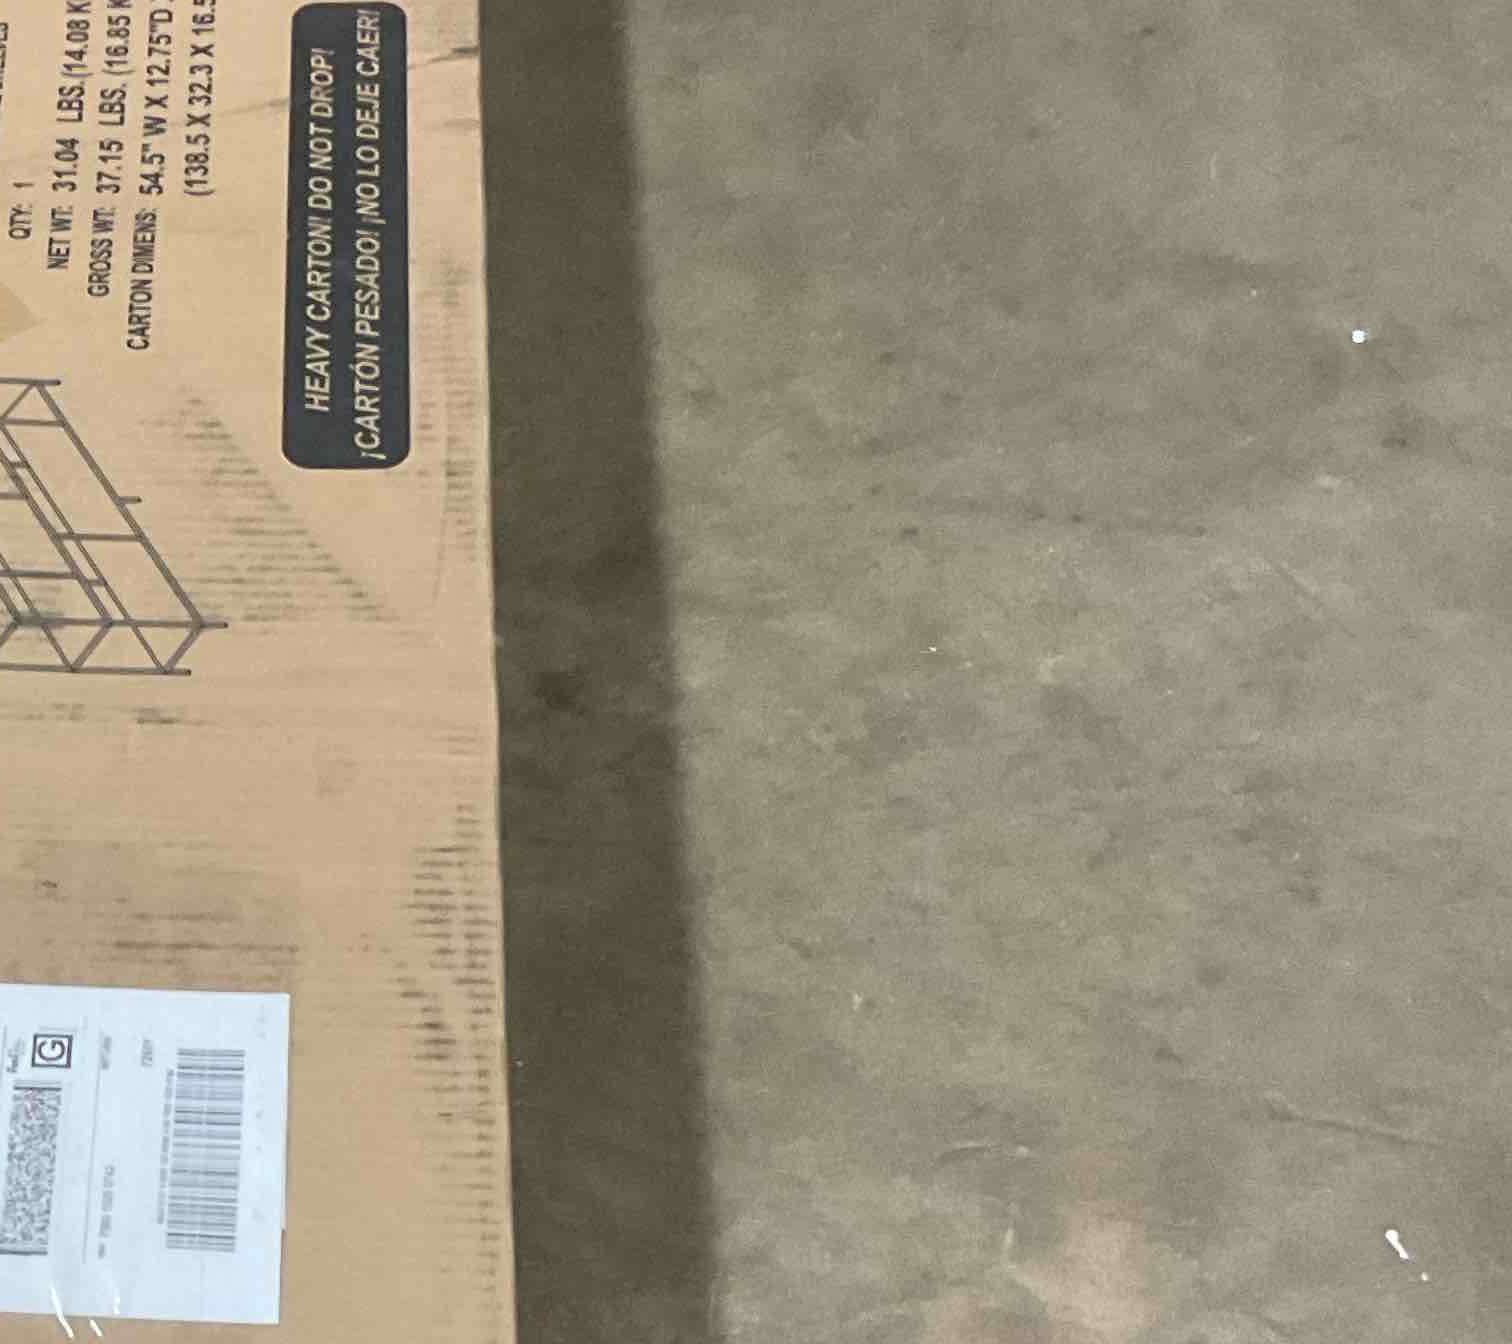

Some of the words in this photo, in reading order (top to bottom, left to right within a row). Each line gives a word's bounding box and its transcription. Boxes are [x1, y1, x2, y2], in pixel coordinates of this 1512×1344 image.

[101, 15, 136, 75] (16.85
[145, 9, 174, 88] 12.75"D
[190, 43, 214, 58] X
[356, 8, 382, 76] CAER!
[98, 83, 128, 127] LBS.
[145, 95, 169, 109] X
[188, 64, 213, 107] 32.3
[309, 47, 336, 117] DROP!
[143, 116, 167, 137] W
[186, 112, 211, 128] X
[356, 83, 380, 140] DEJE
[52, 138, 79, 193] 31.04
[96, 139, 123, 194] 37.15
[139, 143, 165, 196] 54.5"
[184, 134, 216, 197] (138.5
[309, 122, 334, 171] NOT
[356, 144, 380, 177] LO
[50, 206, 73, 233] WT:
[308, 176, 333, 210] DO
[355, 183, 387, 225] ¡NO
[8, 203, 32, 240] QTY:
[92, 207, 116, 235] WT:
[131, 208, 158, 274] DIMENS:
[47, 238, 71, 270] NET
[87, 238, 112, 298] GROSS
[306, 216, 333, 321] CARTON!
[354, 230, 381, 337] PESADO!
[126, 279, 153, 351] CARTON
[304, 325, 331, 412] HEAVY
[348, 342, 387, 460] ¡CARTÓN
[38, 1039, 65, 1062] G
